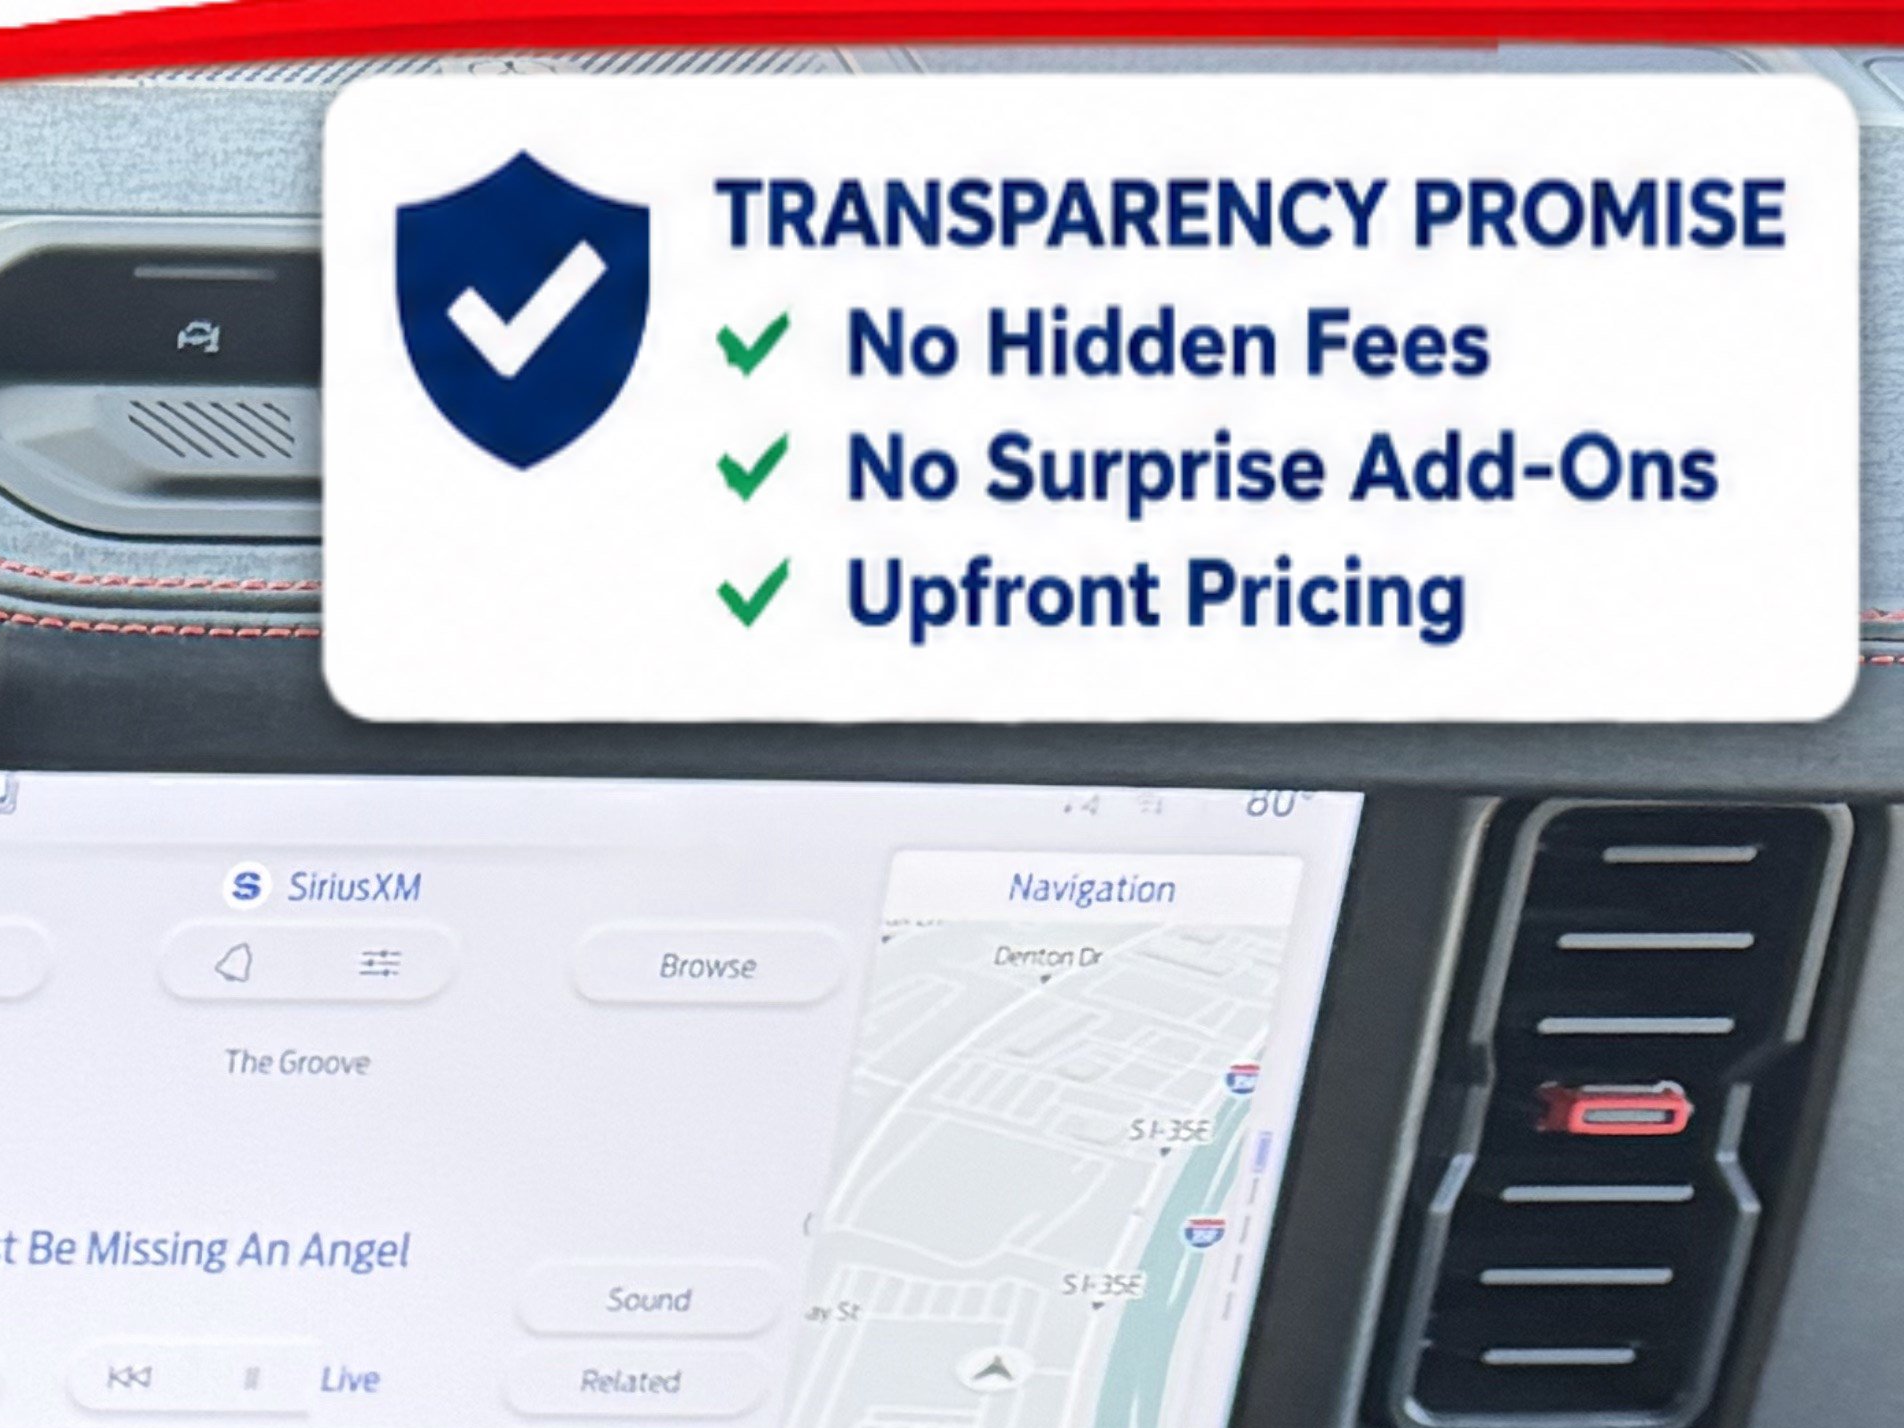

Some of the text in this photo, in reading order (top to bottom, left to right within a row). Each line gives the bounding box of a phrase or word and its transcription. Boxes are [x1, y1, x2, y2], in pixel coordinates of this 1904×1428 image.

[287, 870, 423, 905] SiriusXM
[1008, 872, 1177, 909] Navigation
[659, 952, 758, 982] Browse
[993, 946, 1104, 969] Denton Dr
[225, 1048, 372, 1078] The Groove
[28, 1230, 78, 1268] Be
[86, 1229, 229, 1275] Missing
[237, 1230, 292, 1269] An
[299, 1230, 412, 1275] Angel
[606, 1285, 693, 1314] Sound
[321, 1364, 381, 1396] Live
[580, 1368, 682, 1396] Related
